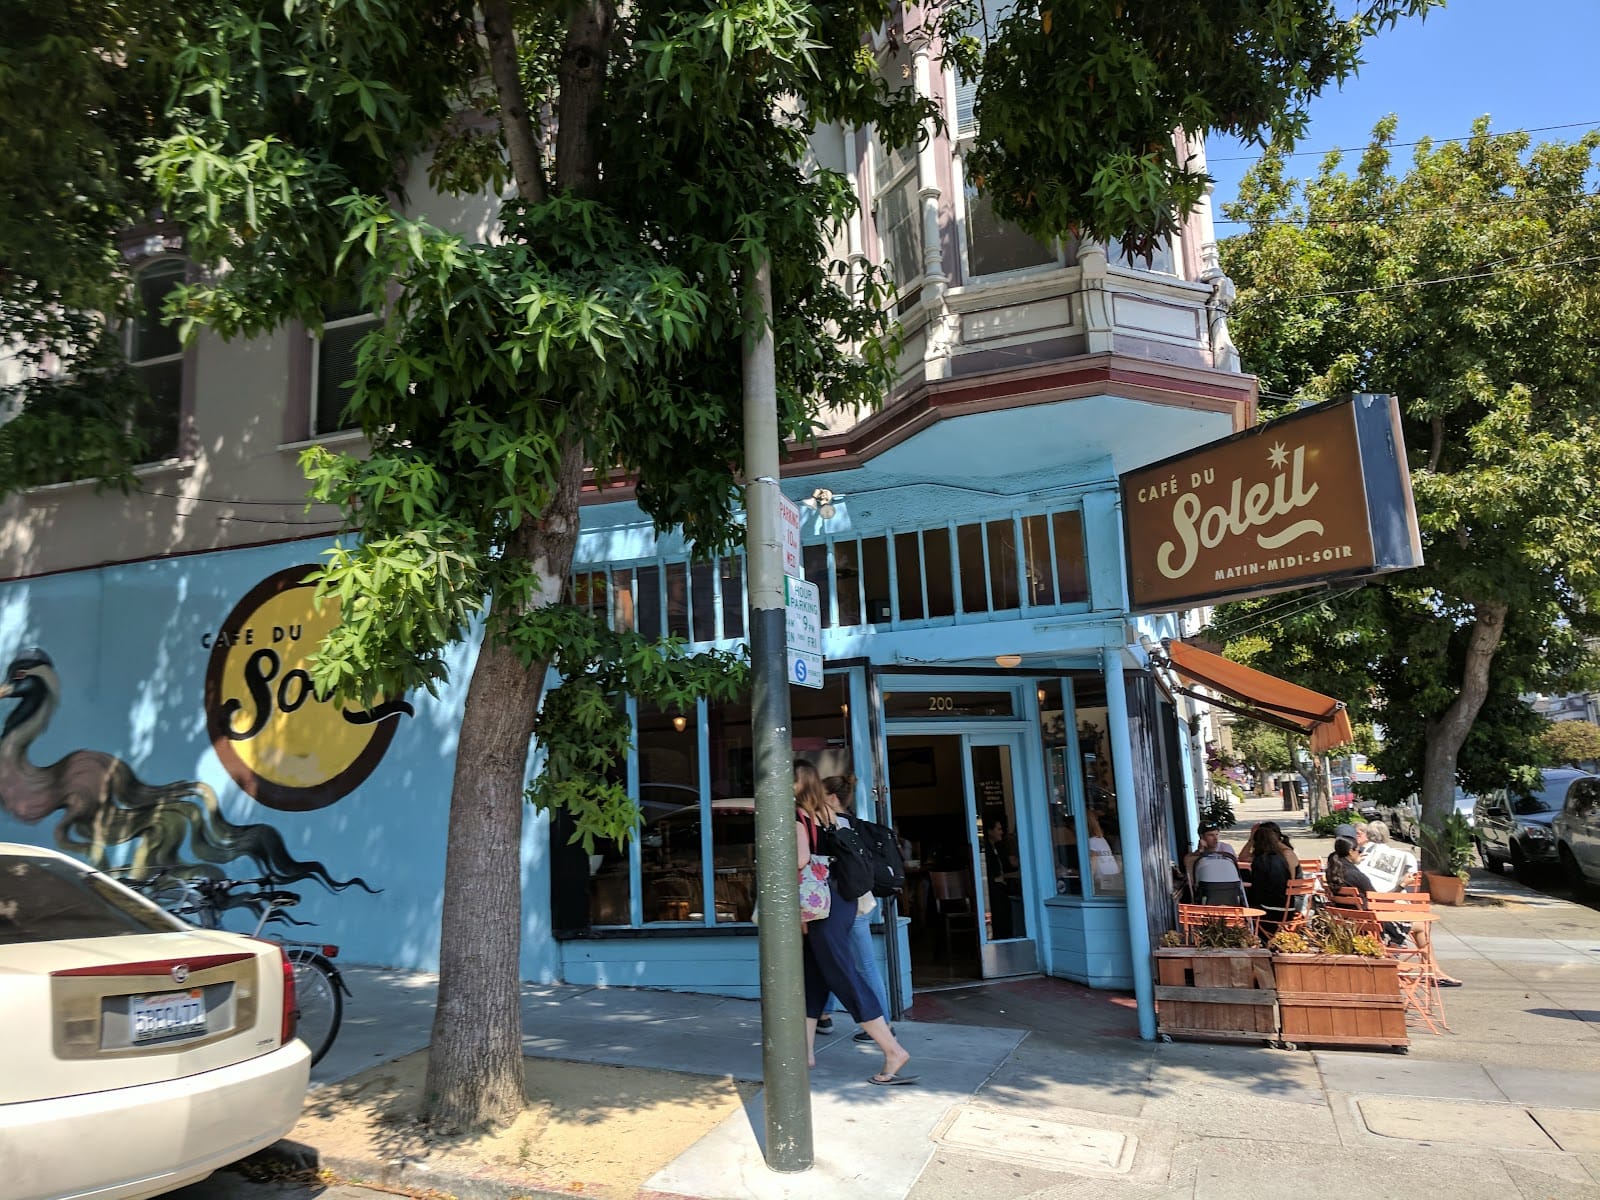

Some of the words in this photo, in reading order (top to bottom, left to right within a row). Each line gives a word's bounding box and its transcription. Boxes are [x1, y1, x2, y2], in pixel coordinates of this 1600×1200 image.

[1138, 474, 1178, 503] CAFÉ
[1190, 468, 1215, 489] DU
[1157, 443, 1319, 579] Soleil
[1214, 545, 1352, 580] MATIN-MIDI-SOIR
[794, 584, 813, 600] HOUR
[790, 596, 818, 616] PARKING
[272, 625, 303, 644] DU
[807, 636, 817, 648] FRI
[928, 696, 953, 711] 200
